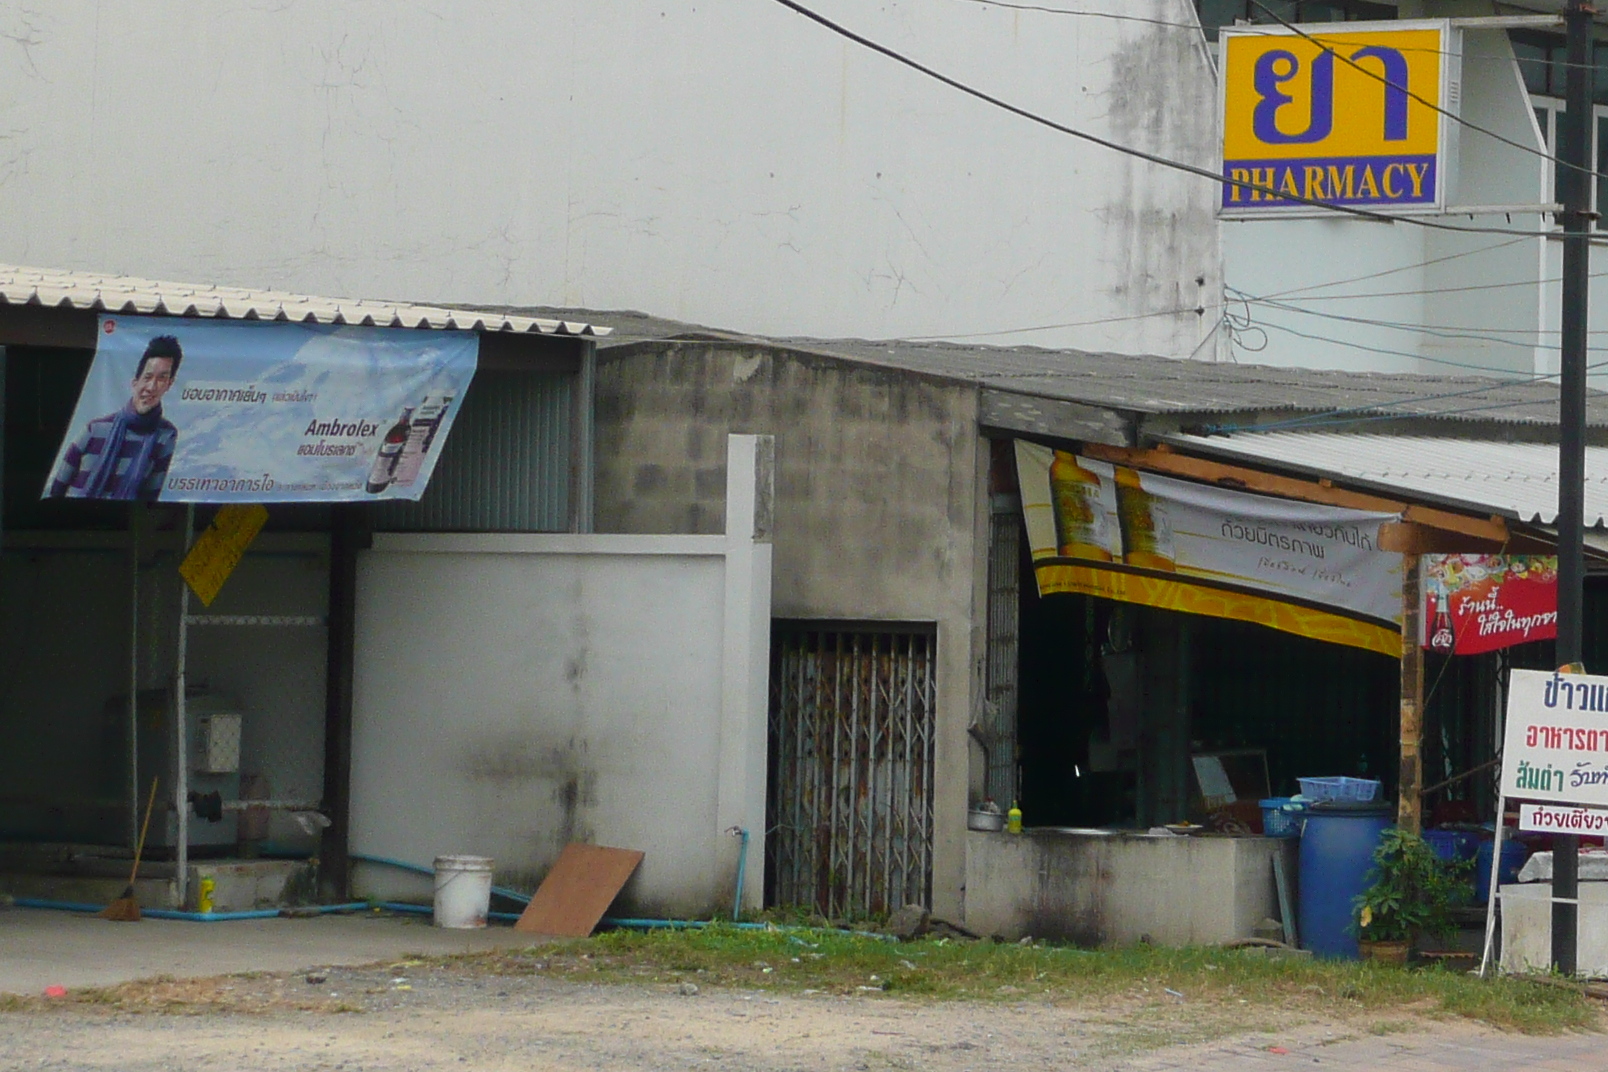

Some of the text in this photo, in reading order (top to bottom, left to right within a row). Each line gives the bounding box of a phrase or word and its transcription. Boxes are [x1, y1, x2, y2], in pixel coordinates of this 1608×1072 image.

[1252, 44, 1409, 145] ยา
[1229, 162, 1430, 203] PHARMACY
[304, 418, 379, 437] Ambrolex
[1477, 608, 1558, 639] ใส่ใจในทุกจา
